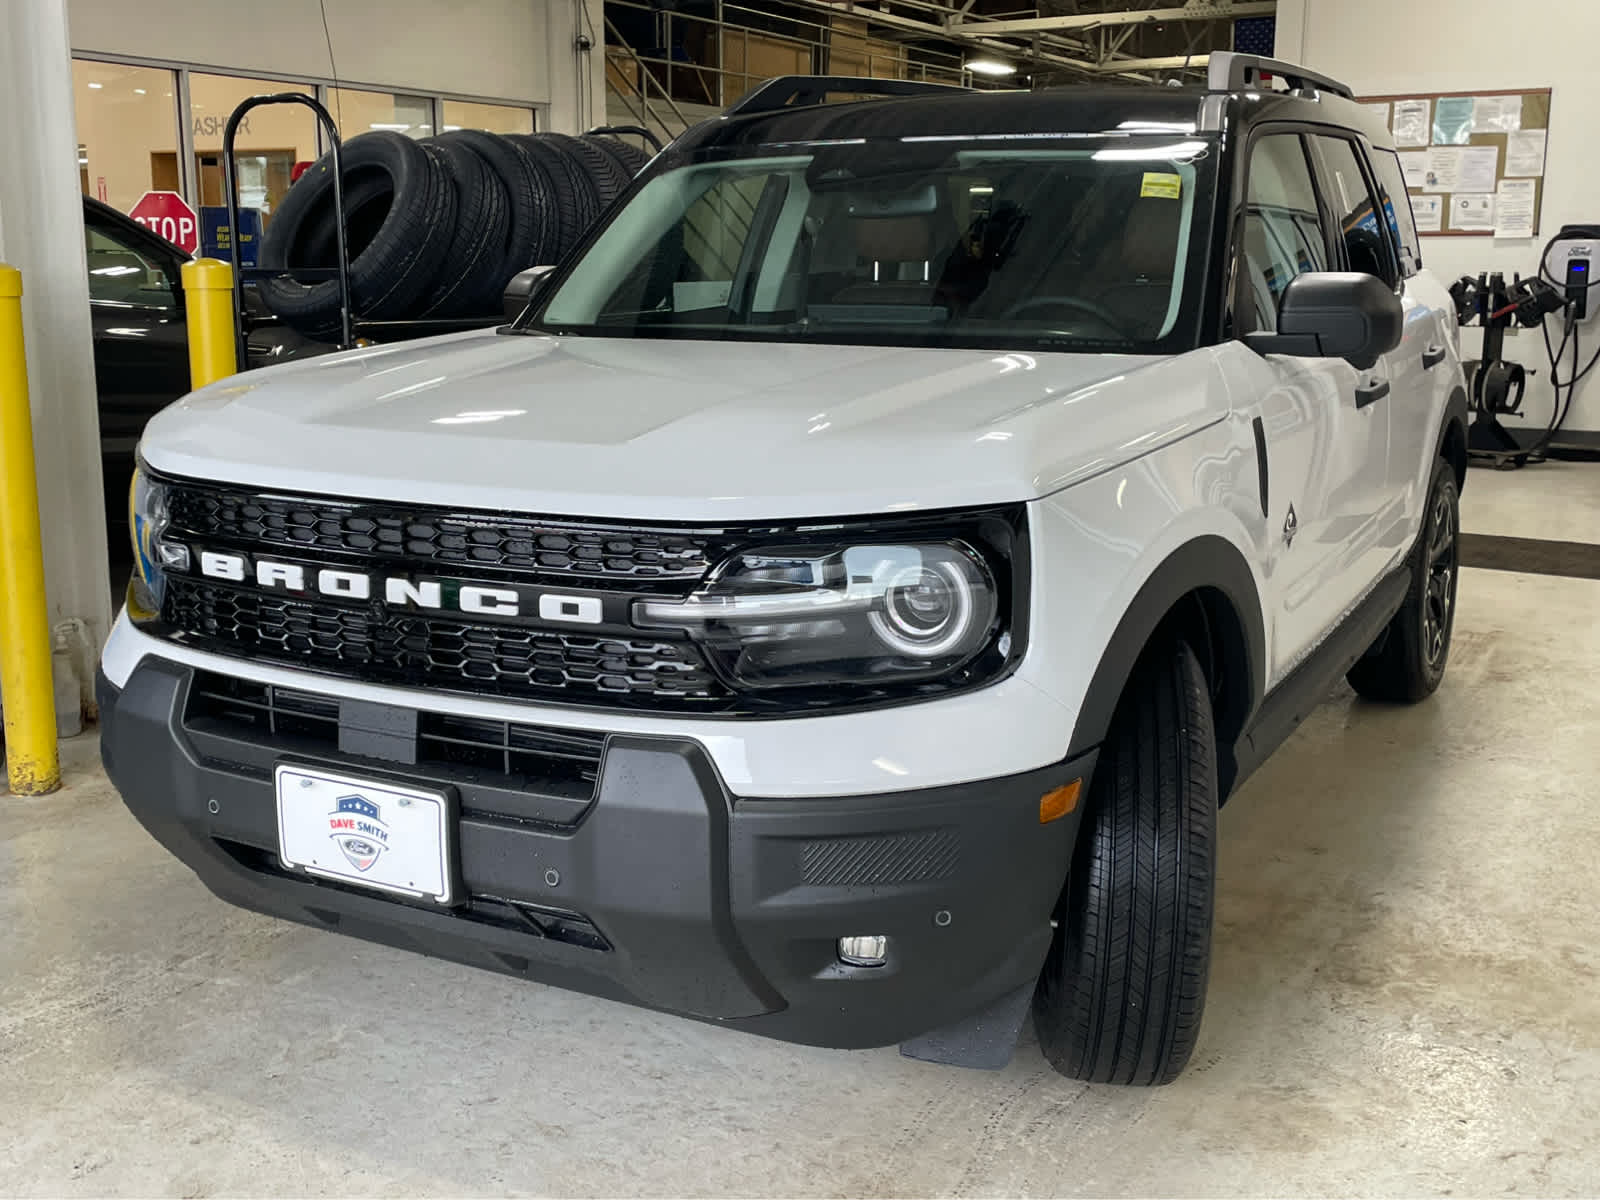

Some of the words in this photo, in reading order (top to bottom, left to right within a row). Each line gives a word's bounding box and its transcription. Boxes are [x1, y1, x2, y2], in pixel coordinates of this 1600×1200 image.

[193, 116, 250, 136] ASHR
[135, 216, 193, 245] TOP
[201, 551, 603, 624] BRONCO
[330, 818, 355, 829] DAVE
[357, 821, 388, 841] SMITH
